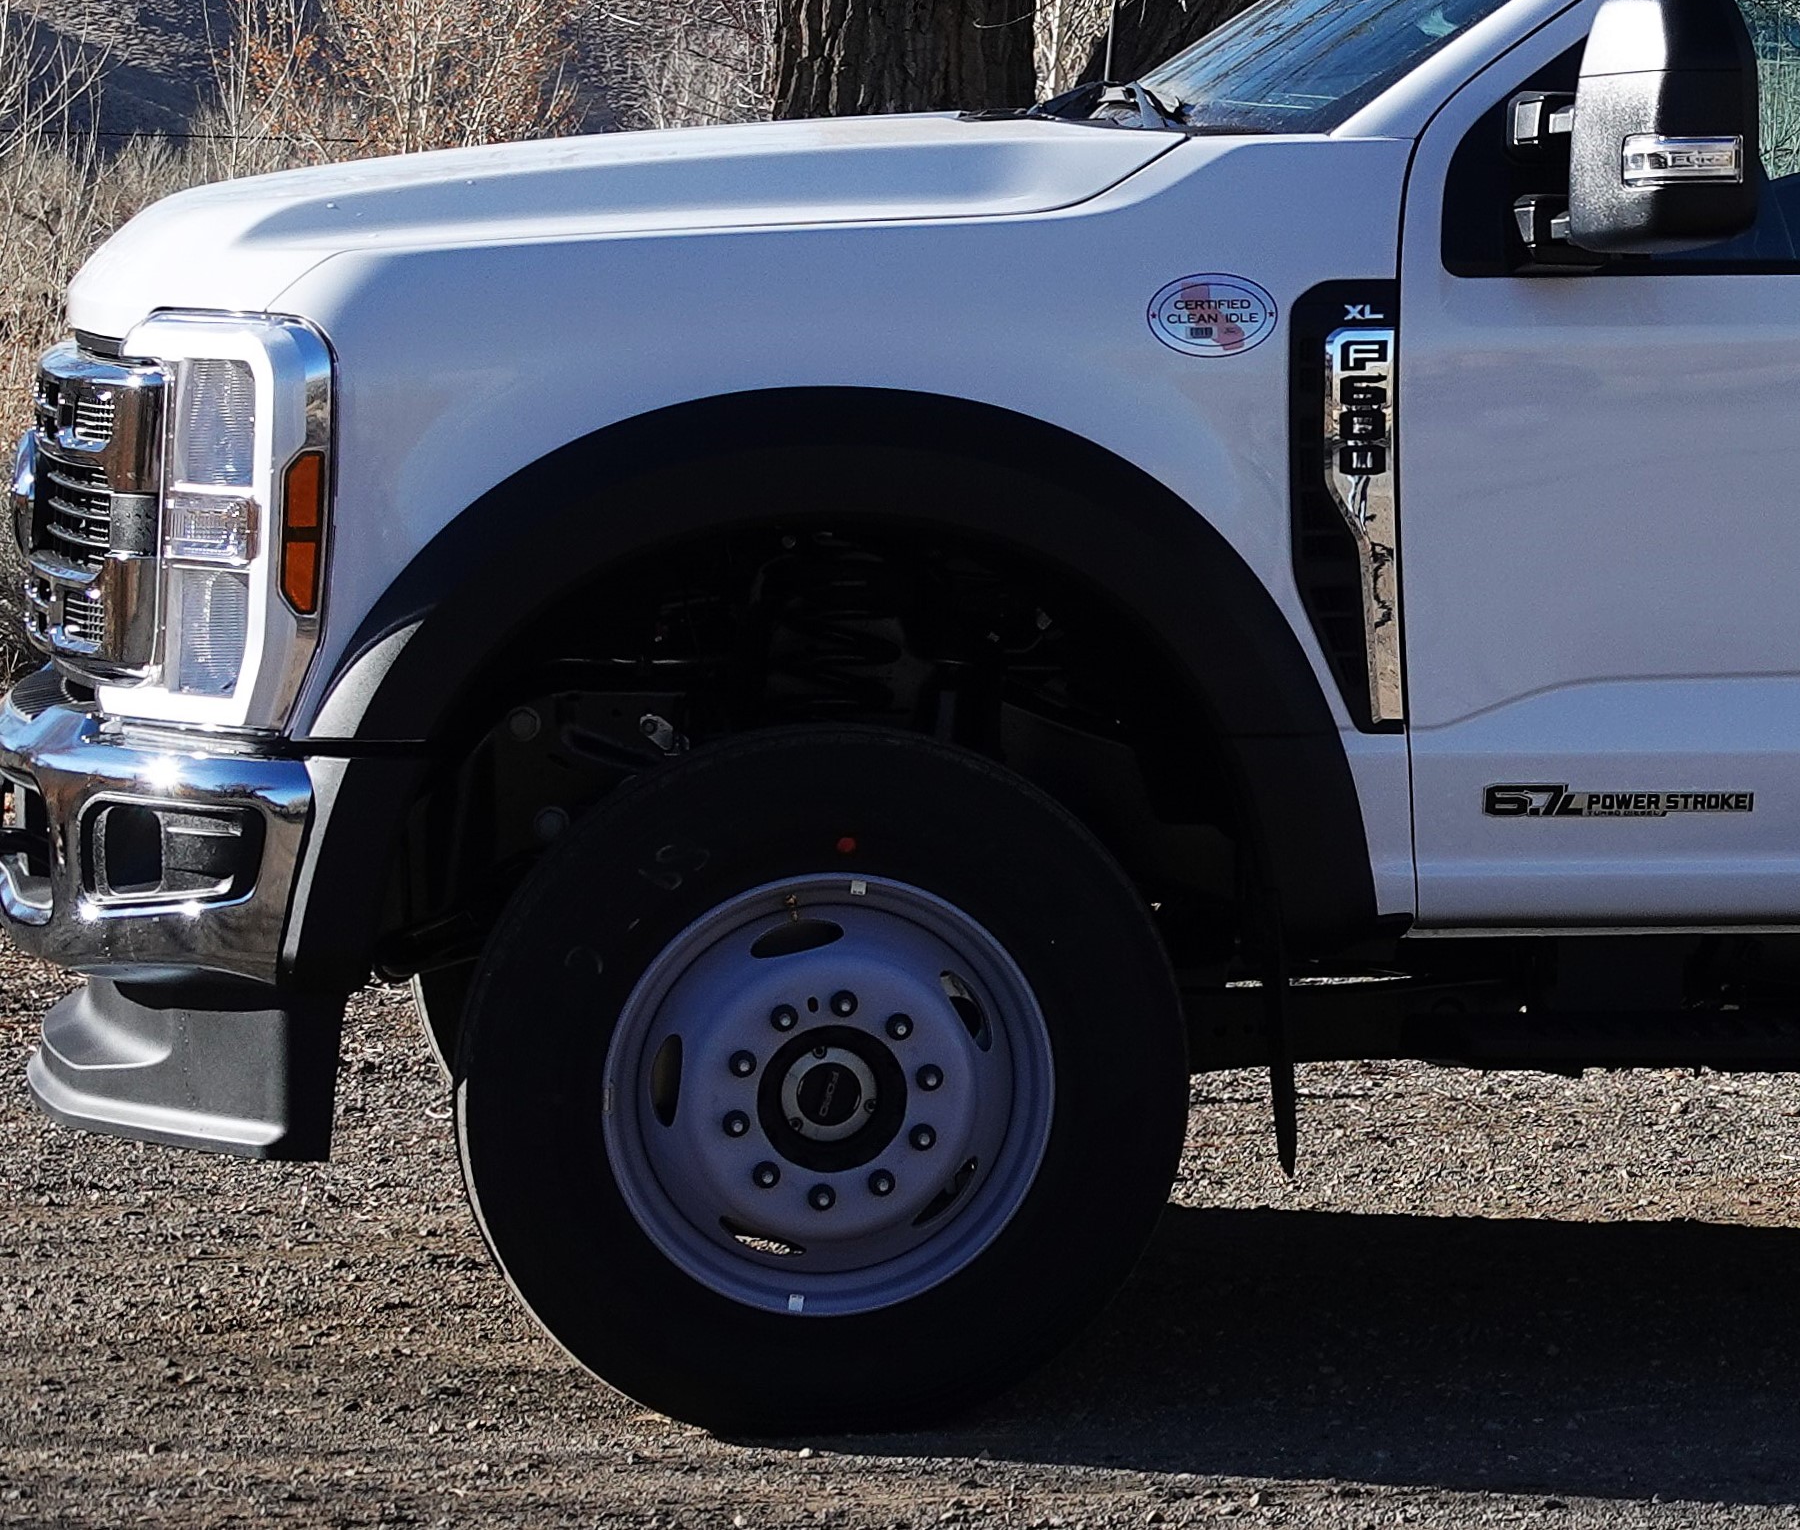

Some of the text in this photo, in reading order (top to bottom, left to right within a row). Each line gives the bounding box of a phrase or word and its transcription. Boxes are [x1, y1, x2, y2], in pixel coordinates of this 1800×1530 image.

[1173, 299, 1251, 311] CERTIFIED
[1344, 304, 1384, 320] XL
[1166, 313, 1259, 324] CLEAN IDLE
[1484, 783, 1747, 817] 6.7L POWER STROKE
